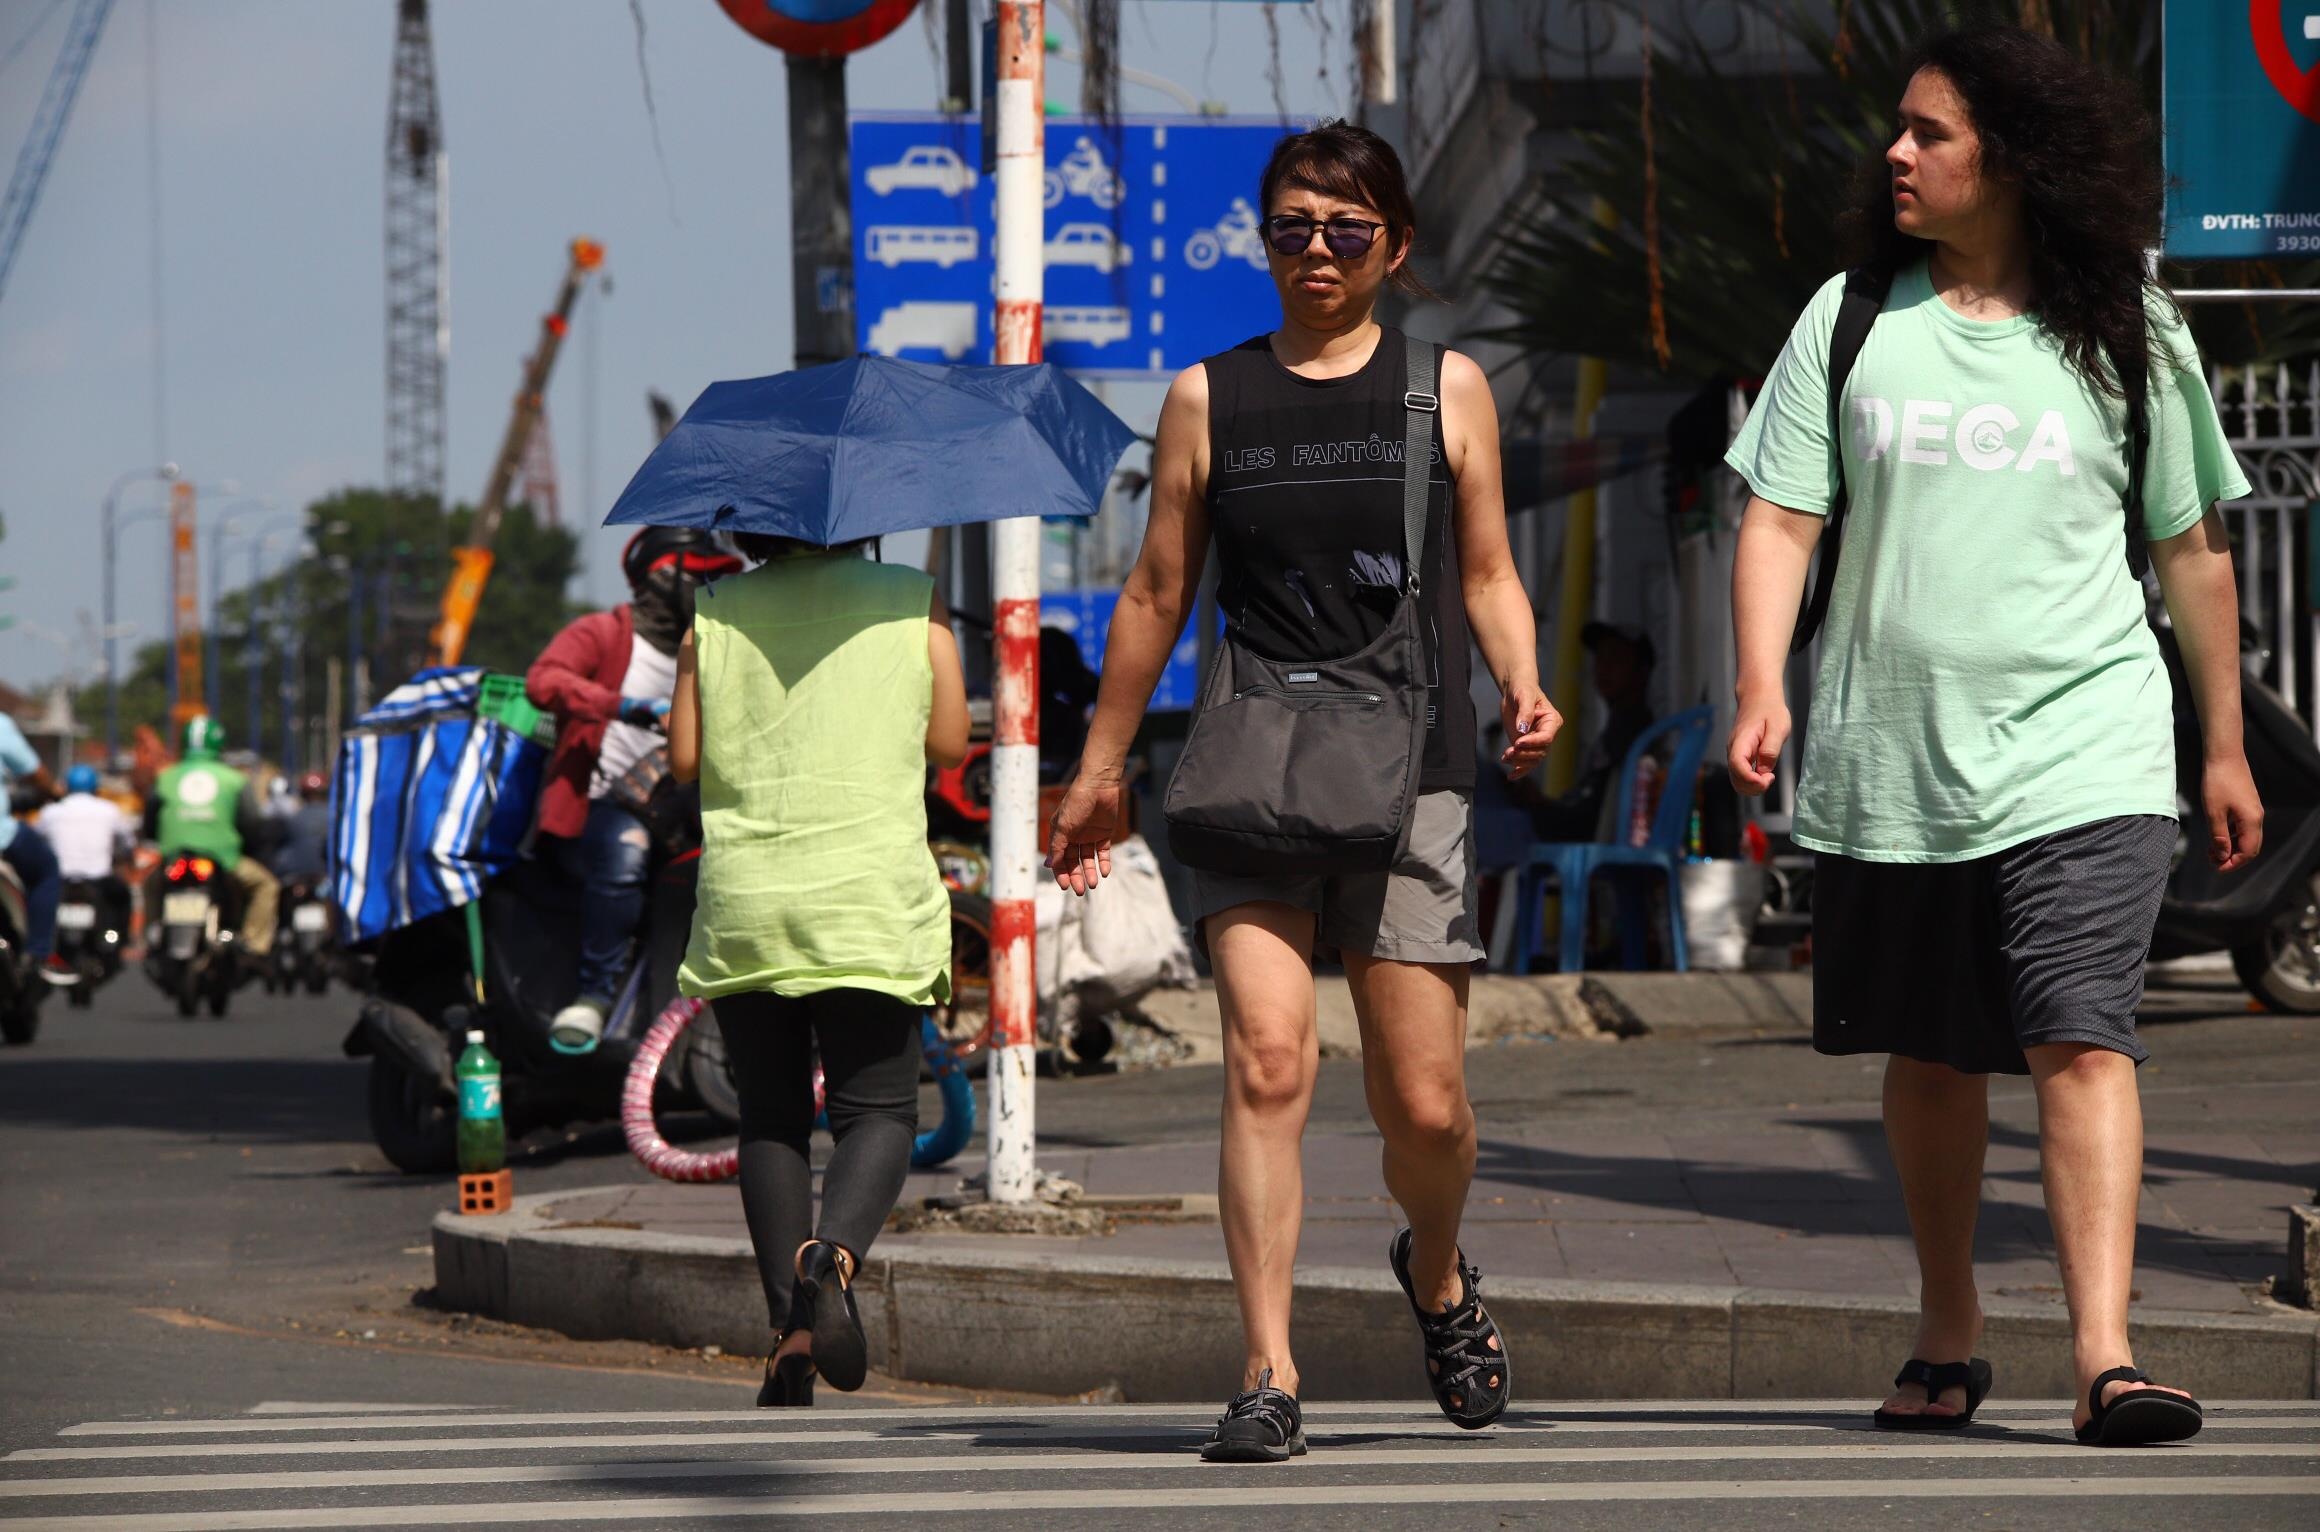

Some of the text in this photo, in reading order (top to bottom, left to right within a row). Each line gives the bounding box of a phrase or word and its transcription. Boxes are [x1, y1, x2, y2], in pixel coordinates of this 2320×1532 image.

[1225, 433, 1441, 472] LES FANTÔMS
[1853, 395, 2076, 476] DECA
